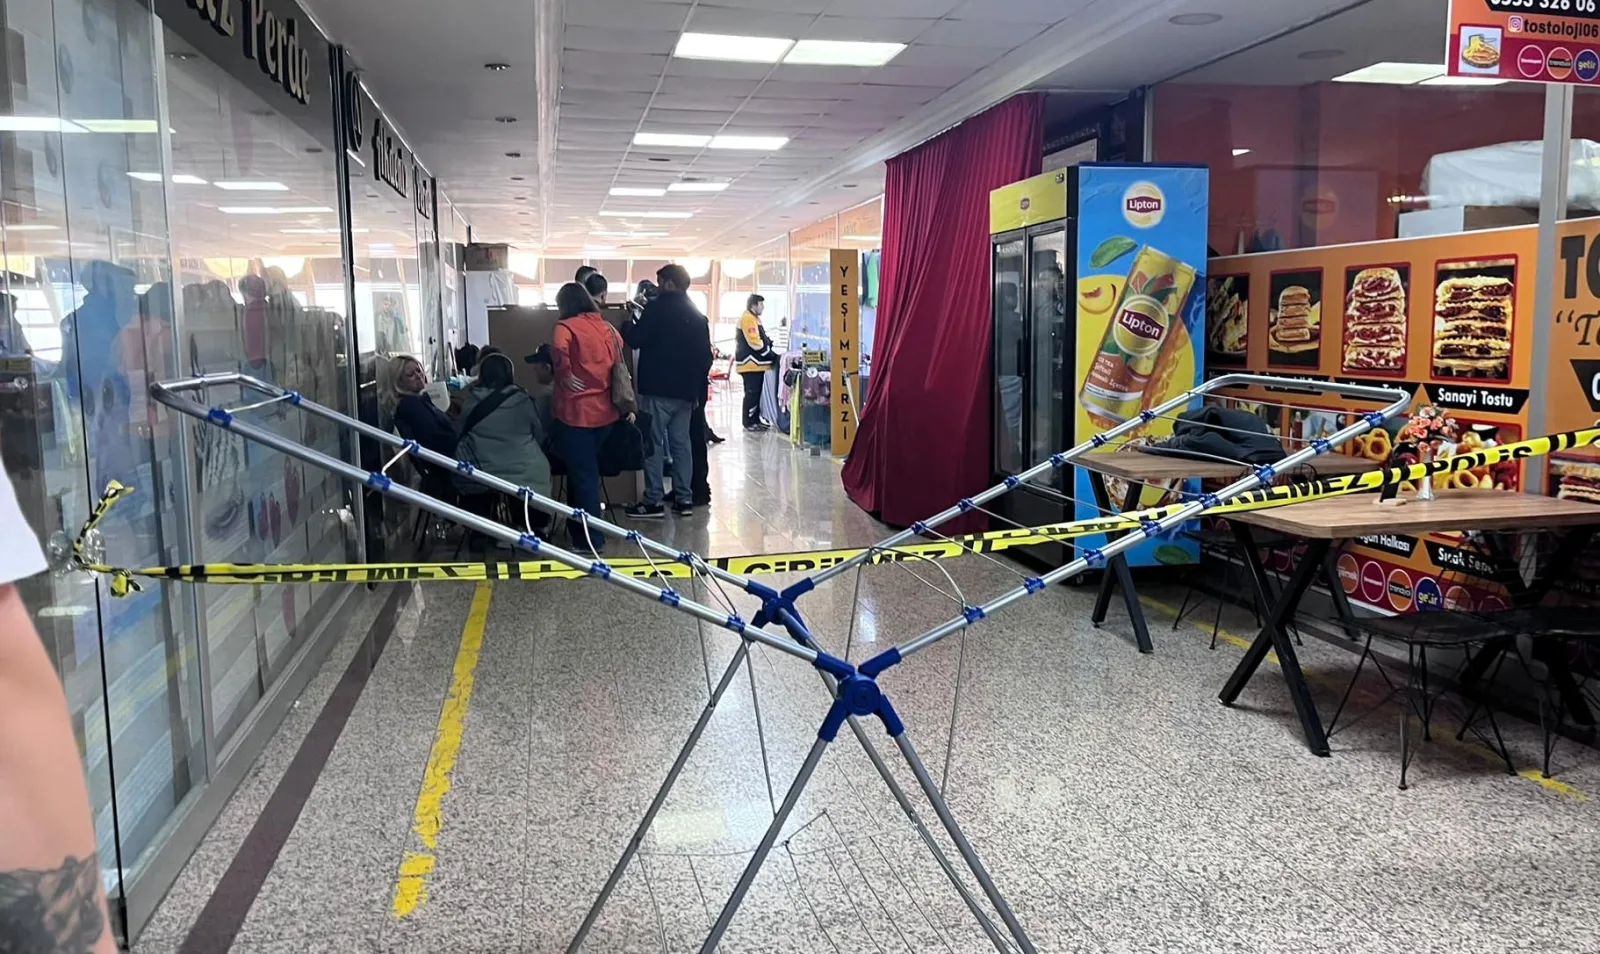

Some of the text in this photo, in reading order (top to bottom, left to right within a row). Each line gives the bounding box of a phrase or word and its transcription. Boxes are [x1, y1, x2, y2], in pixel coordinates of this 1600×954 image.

[244, 0, 310, 105] Perde
[1130, 199, 1159, 211] Lipton
[1122, 312, 1160, 337] Lipton
[1438, 387, 1513, 407] Sanayi Tostu
